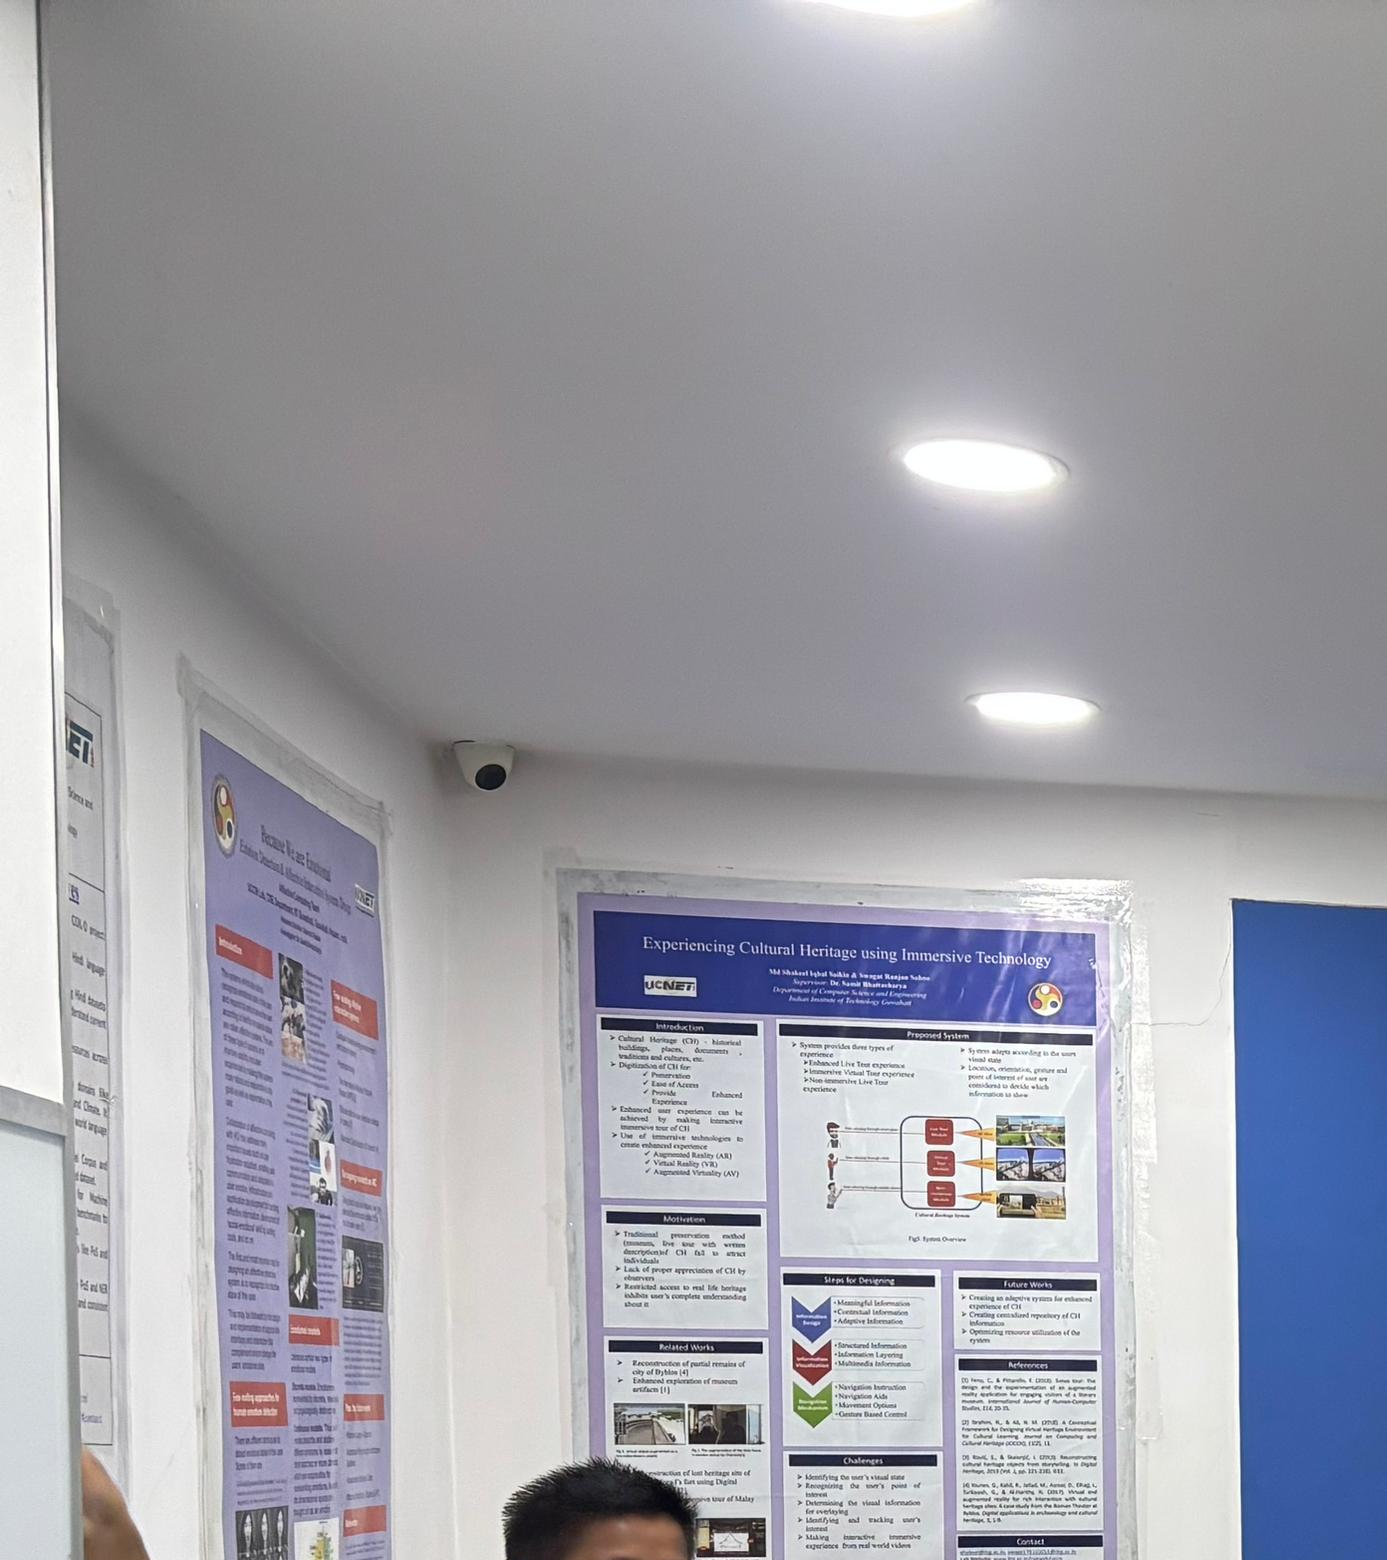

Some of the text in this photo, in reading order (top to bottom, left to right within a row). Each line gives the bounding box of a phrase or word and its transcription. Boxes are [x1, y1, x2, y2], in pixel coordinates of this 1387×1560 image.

[643, 937, 1051, 968] Experiencing Cultural Heritage using Immersive Technology
[656, 1023, 704, 1031] Introduction
[824, 1276, 844, 1284] Steps
